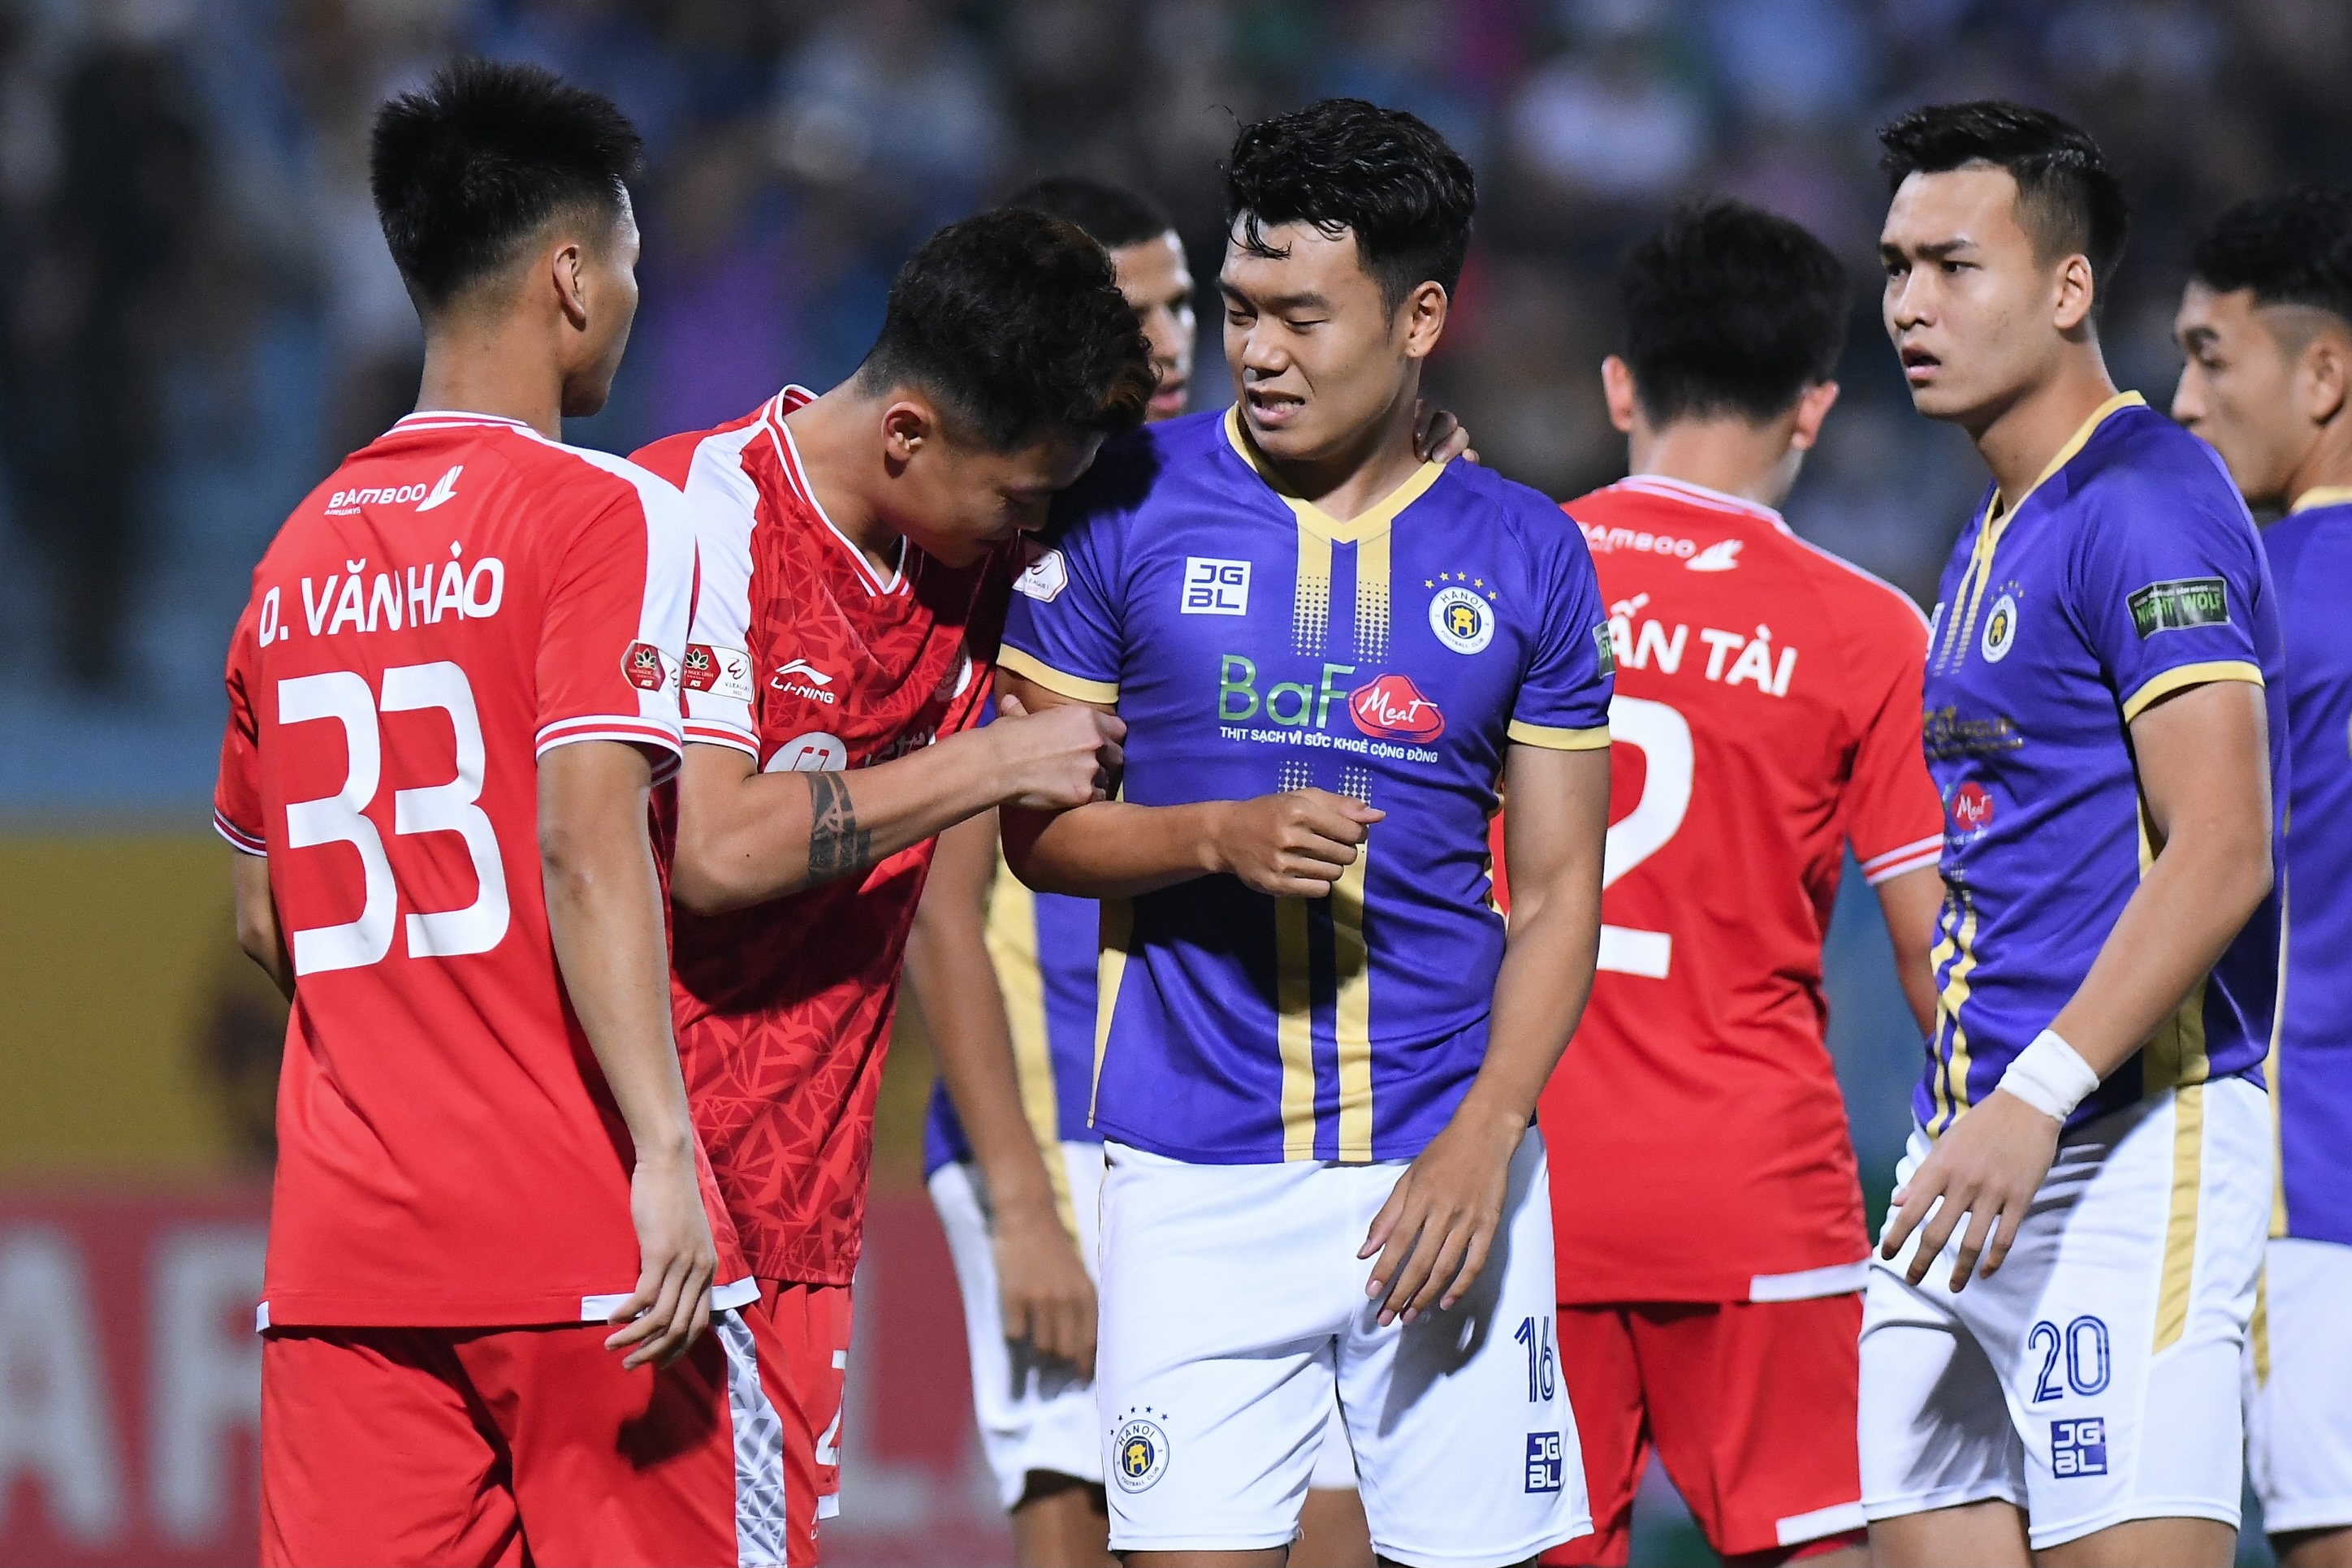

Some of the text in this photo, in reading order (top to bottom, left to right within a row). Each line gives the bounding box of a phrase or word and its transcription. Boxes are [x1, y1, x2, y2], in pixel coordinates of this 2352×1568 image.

[327, 483, 427, 508] BAMBOO
[324, 507, 361, 516] AIRWAYS
[1191, 564, 1243, 585] JG
[1188, 587, 1239, 609] BL
[1440, 590, 1484, 609] HANOI
[2181, 592, 2221, 616] WOLF
[1700, 623, 1798, 698] TÀI
[770, 676, 834, 704] LI-NING
[1219, 654, 1438, 729] BaF Meat
[1220, 727, 1249, 741] THỊT
[1251, 729, 1286, 744] SẠCH
[1370, 742, 1405, 758] CỘNG
[1407, 745, 1438, 762] ĐỒNG
[278, 660, 510, 976] 33
[1514, 1315, 1554, 1402] 16
[2029, 1315, 2111, 1404] 20
[1118, 1424, 1156, 1446] HANOI
[2054, 1421, 2102, 1449] JG
[1529, 1436, 1561, 1462] JG
[2055, 1449, 2103, 1475] BL
[1528, 1464, 1559, 1488] BL
